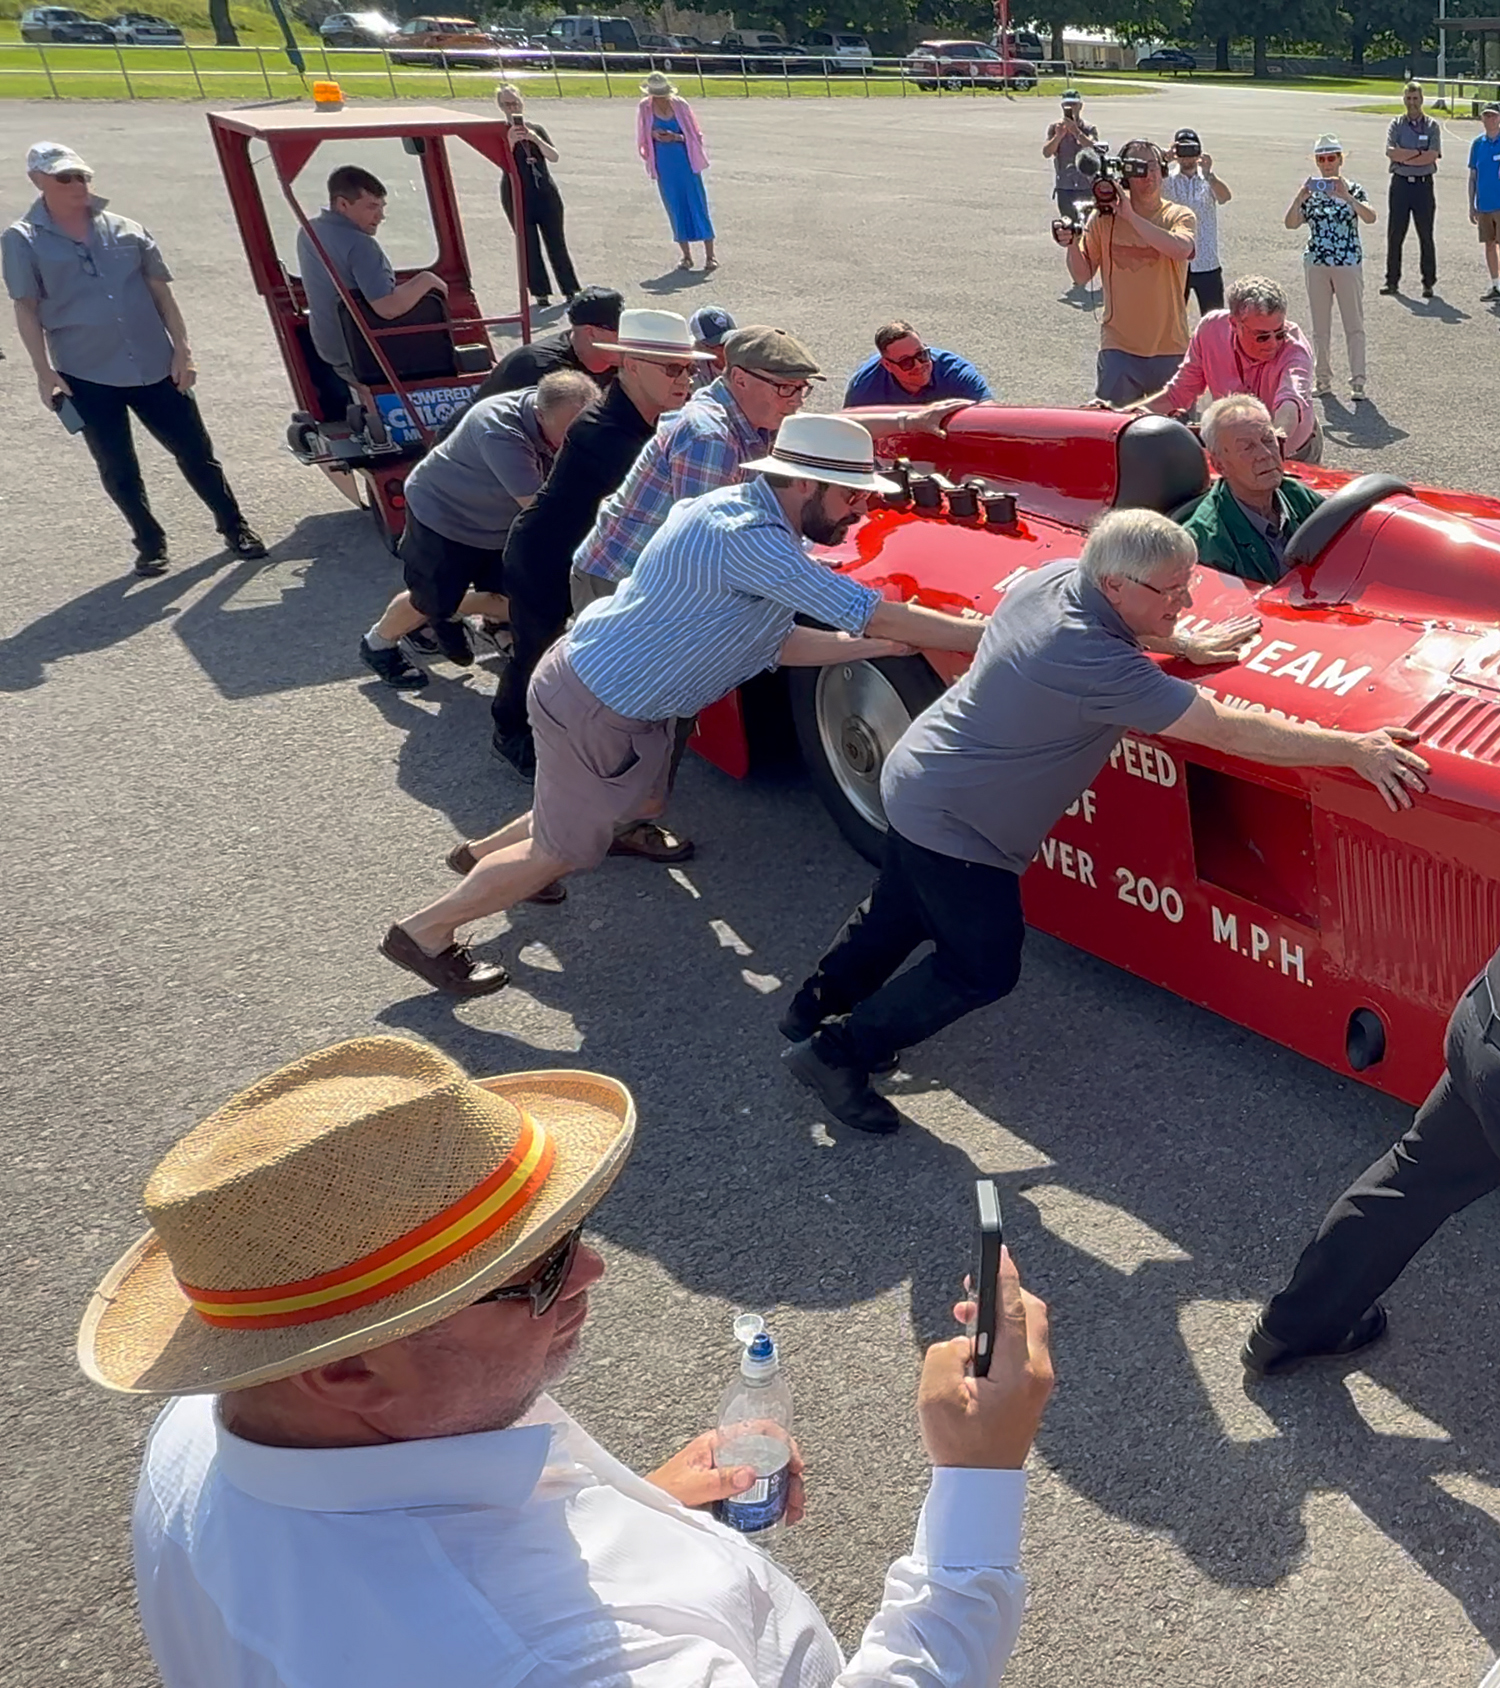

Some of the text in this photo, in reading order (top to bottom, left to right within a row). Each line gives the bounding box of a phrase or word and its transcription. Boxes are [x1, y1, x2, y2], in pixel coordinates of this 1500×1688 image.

[1110, 737, 1177, 788] PEED
[1031, 836, 1313, 987] VER 200 M.P.H.
